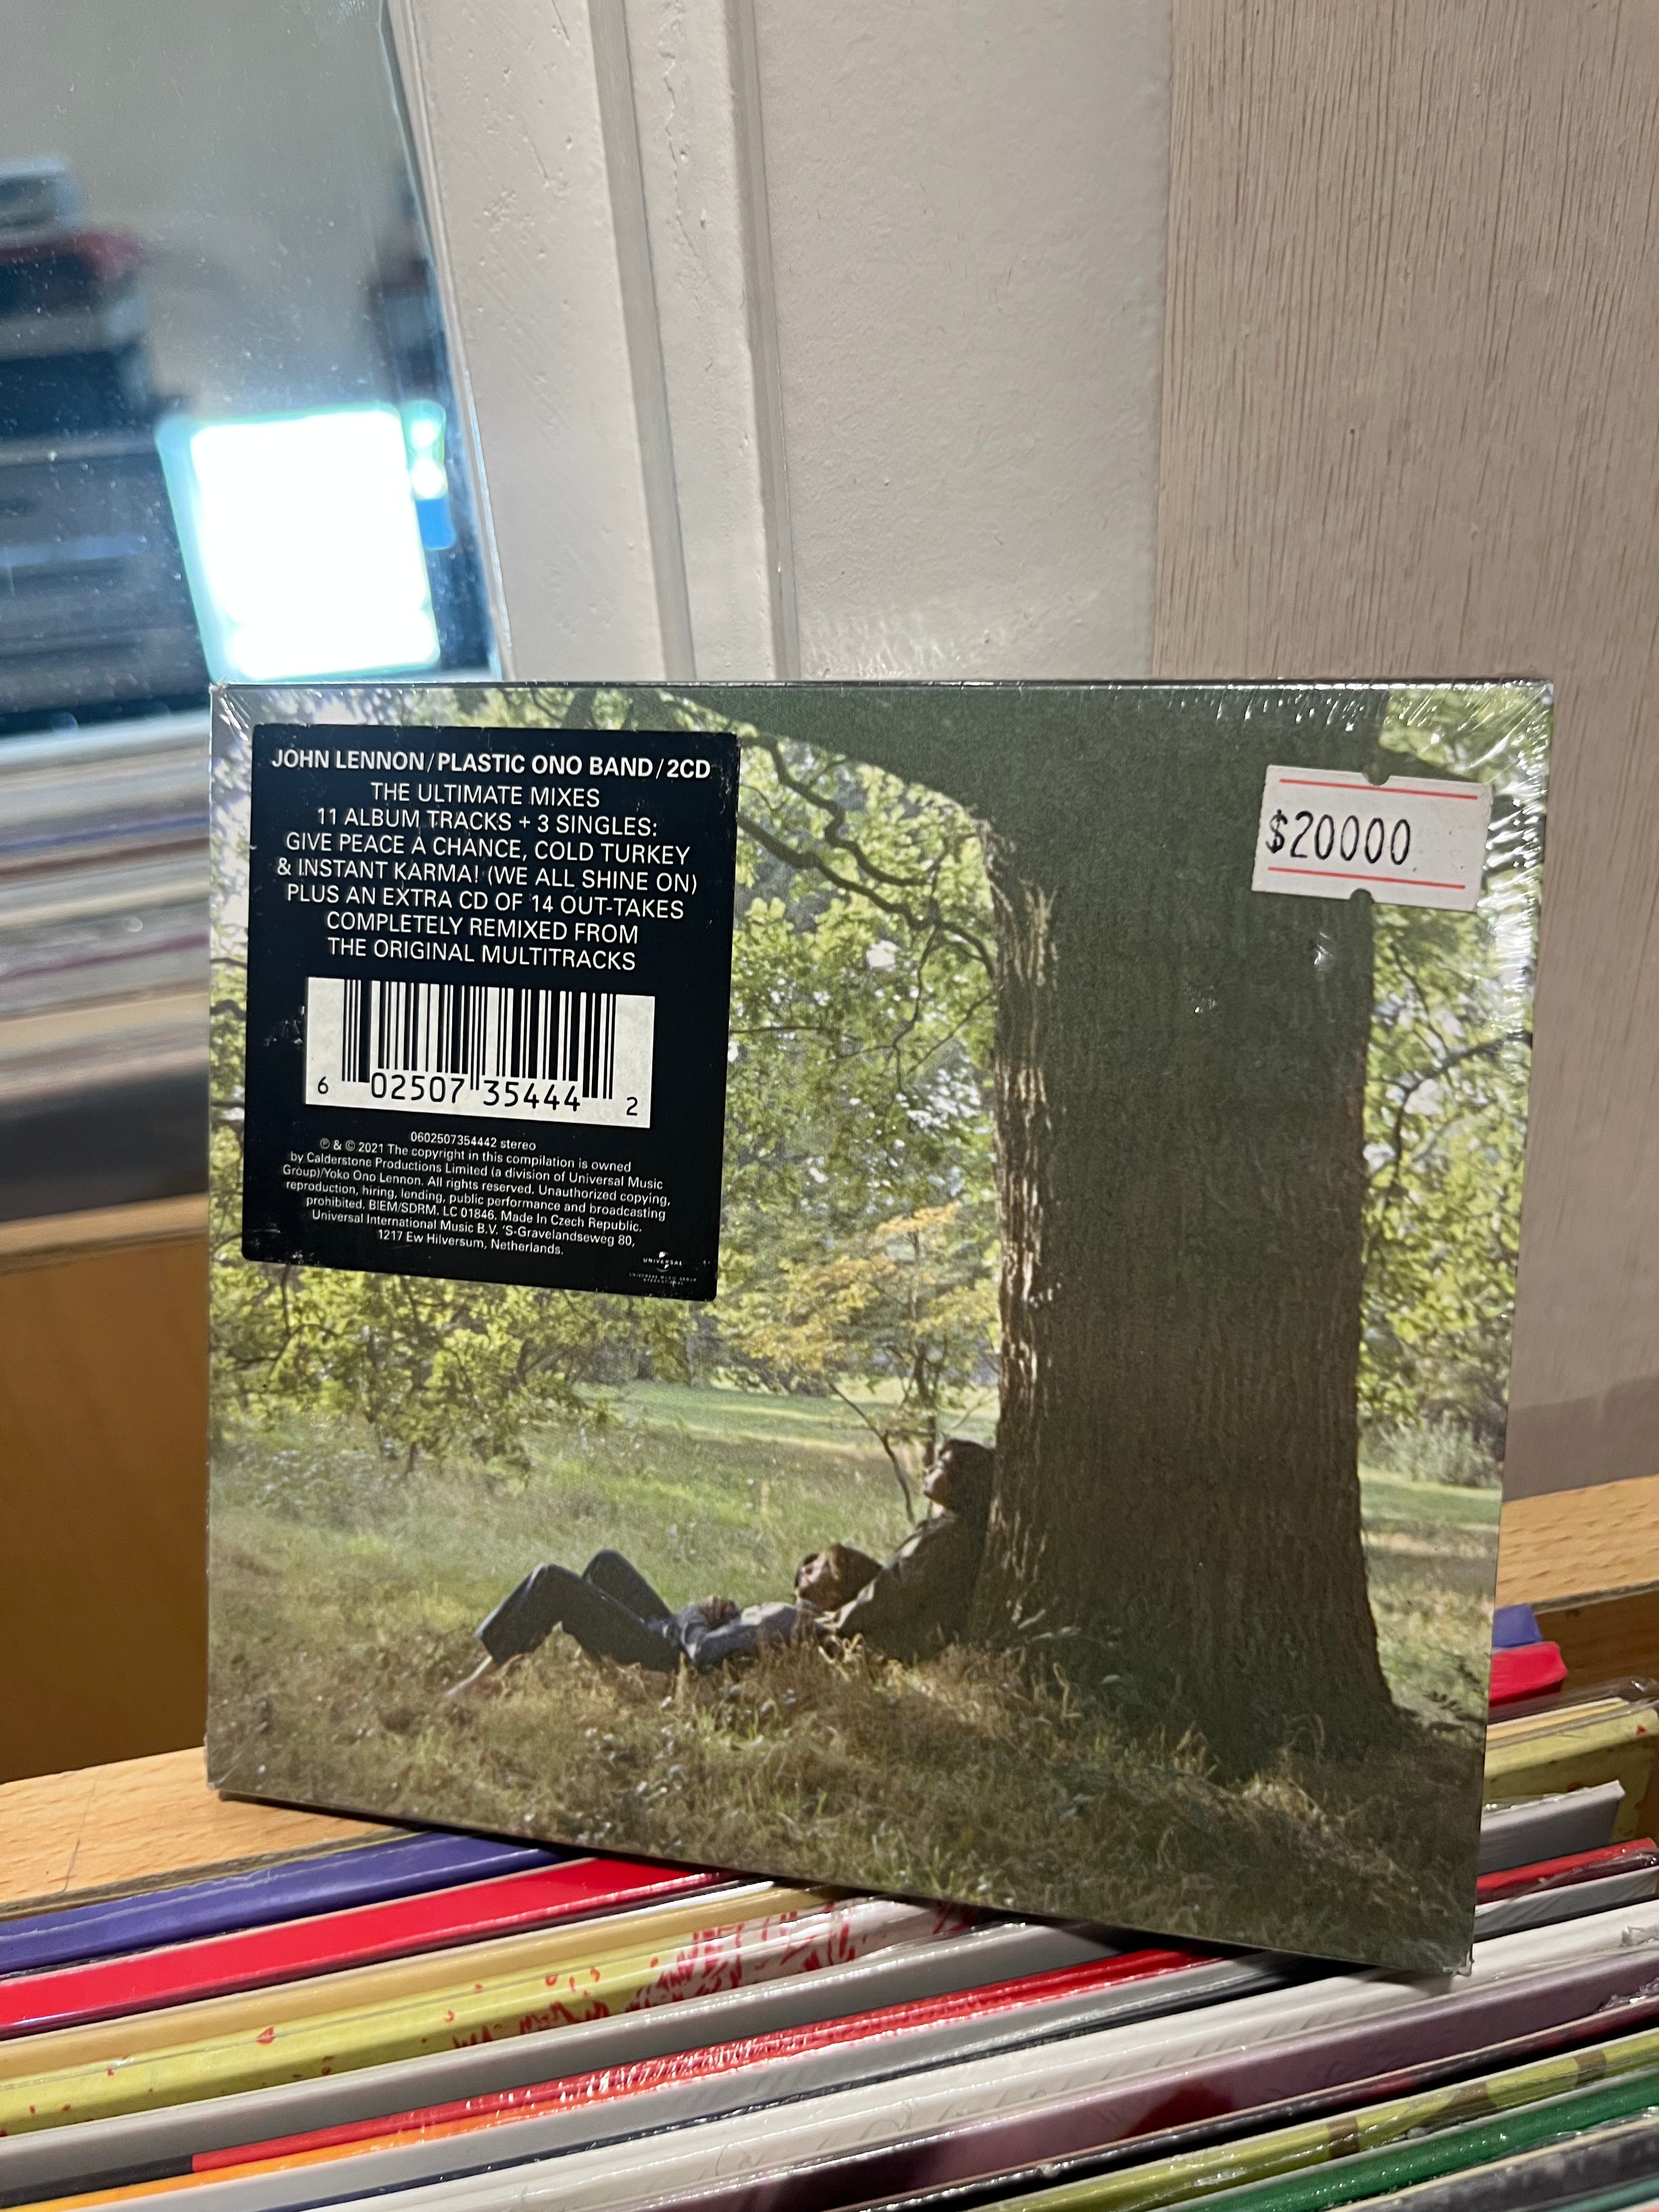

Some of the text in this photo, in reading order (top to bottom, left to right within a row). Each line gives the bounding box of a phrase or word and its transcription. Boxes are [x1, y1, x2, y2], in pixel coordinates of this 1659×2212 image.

[271, 748, 329, 769] JOHN
[531, 754, 582, 775] ONO
[370, 781, 600, 808] THE ULTIMATE MIXES
[317, 807, 657, 837] 11 ALBUM TRACKS + 3 SINGLES:
[1266, 809, 1410, 865] $20000
[285, 831, 690, 865] GIVE PEACE A CHANCE, COLD TURKEY
[276, 856, 697, 895] & INSTANT KARMA! (WE ALL SHINE ON)
[287, 883, 684, 919] PLUS AN EXTRA CD OF 14 OUT-TAKES
[326, 910, 638, 944] COMPLETELY REMIXED FROM
[327, 936, 635, 970] THE ORIGINAL MULTITRACKS
[317, 1073, 638, 1116] 6 02507 35444 2
[332, 1139, 342, 1150] &
[358, 1141, 383, 1153] 2021
[387, 1143, 408, 1155] The
[411, 1148, 465, 1161] copyright
[468, 1149, 479, 1161] in
[482, 1150, 503, 1163] this
[505, 1154, 574, 1168] compilation
[578, 1157, 588, 1169] is
[591, 1161, 631, 1172] owned
[410, 1131, 536, 1150] 0602507354442 stereo
[290, 1150, 663, 1189] by Calderstone Productions Limited (a division of Universal Music
[285, 1181, 665, 1222] reproduction, hiring, lending, public performance and broadcasting
[352, 1169, 376, 1182] Ono
[379, 1171, 424, 1186] Lennon.
[427, 1175, 443, 1187] All
[445, 1177, 478, 1191] rights
[481, 1182, 534, 1195] reserved.
[538, 1183, 617, 1201] Unauthorized
[619, 1192, 670, 1207] copying,
[306, 1195, 365, 1209] prohibited.
[443, 1205, 458, 1217] LC
[460, 1206, 497, 1221] 01846.
[500, 1209, 533, 1223] Made
[536, 1212, 547, 1224] In
[550, 1214, 584, 1227] Czech
[588, 1216, 642, 1232] Republic.
[312, 1208, 363, 1223] Universal
[366, 1213, 436, 1229] International
[439, 1219, 473, 1233] Music
[477, 1222, 498, 1235] B.V.
[617, 1234, 635, 1248] 80,
[378, 1228, 563, 1255] 1217 Ew Hilversum, Netherlands.
